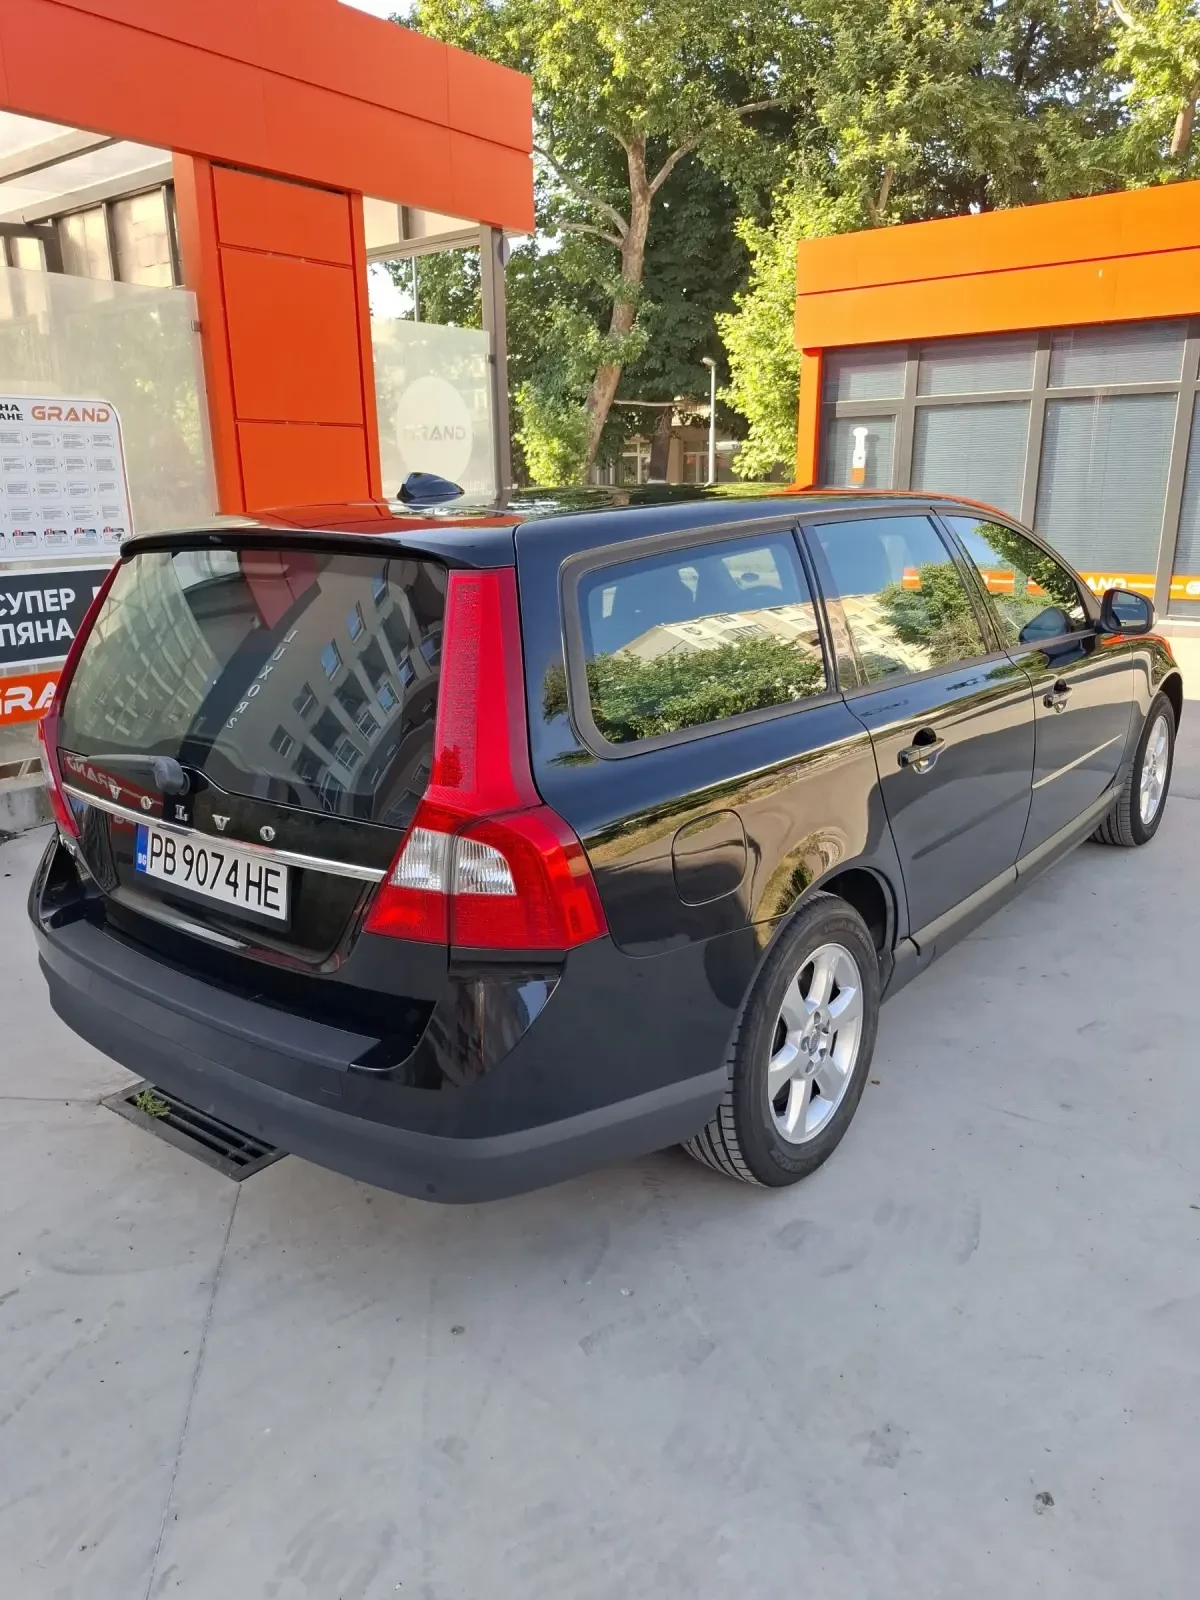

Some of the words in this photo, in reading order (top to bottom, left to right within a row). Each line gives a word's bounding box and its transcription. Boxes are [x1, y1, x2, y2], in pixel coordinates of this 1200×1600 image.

[31, 405, 110, 423] GRAND
[109, 784, 276, 842] VOLVO
[137, 852, 147, 866] BG
[182, 844, 240, 898] 9074
